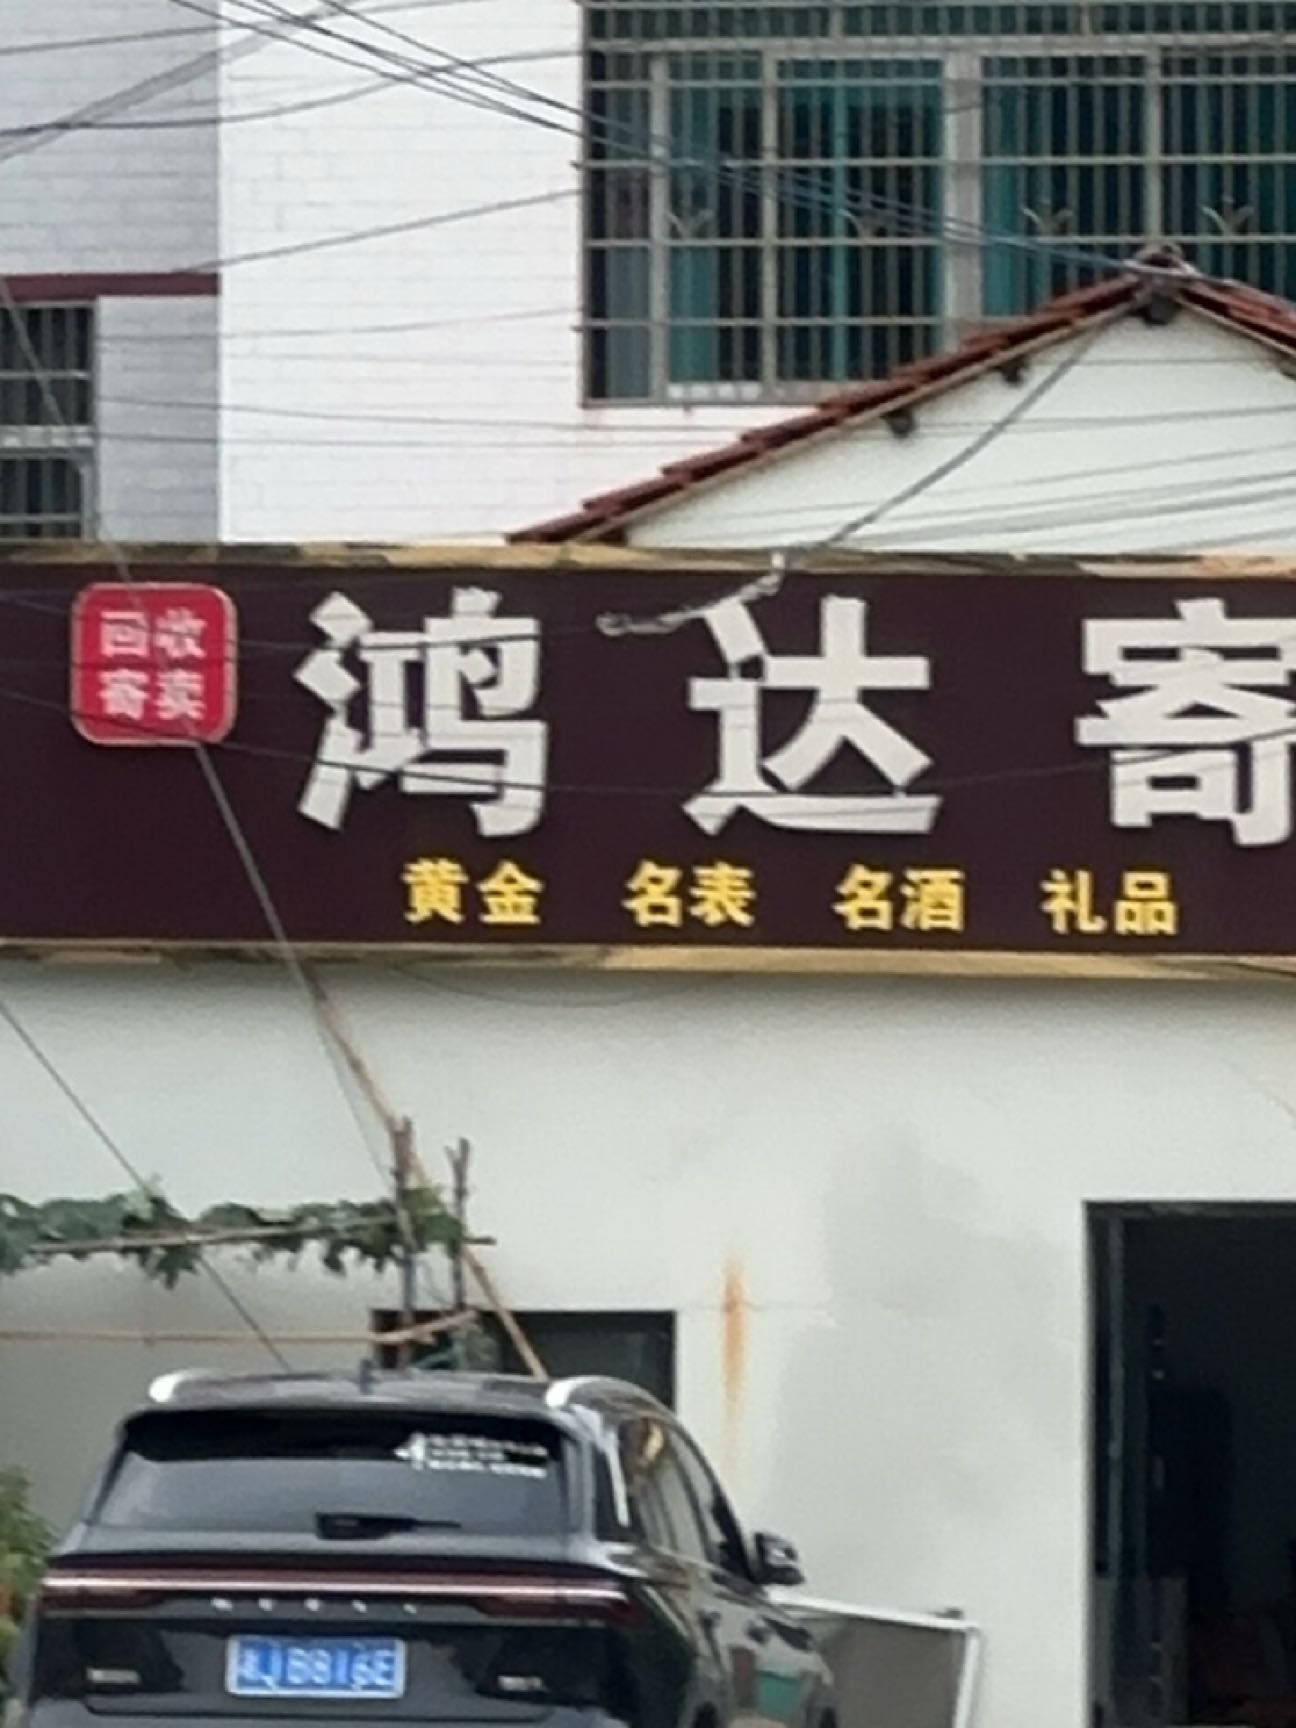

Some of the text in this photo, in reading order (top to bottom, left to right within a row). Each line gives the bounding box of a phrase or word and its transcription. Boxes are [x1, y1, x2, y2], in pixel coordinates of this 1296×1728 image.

[97, 667, 207, 721] 寄卖
[403, 858, 1178, 936] 黄金 名表 名酒 礼品
